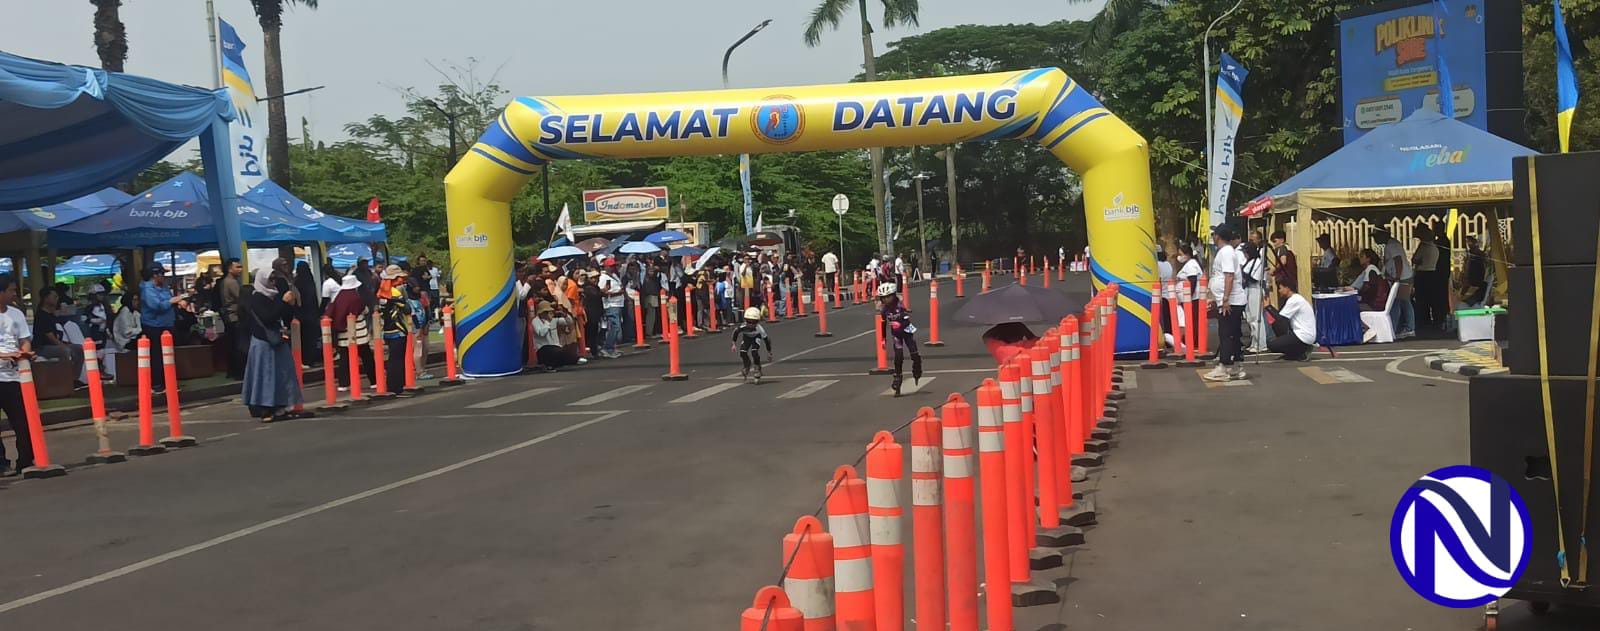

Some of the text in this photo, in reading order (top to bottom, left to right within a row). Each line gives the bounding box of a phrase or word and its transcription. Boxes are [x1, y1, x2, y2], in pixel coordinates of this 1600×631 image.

[538, 106, 740, 145] SELAMAT
[831, 88, 1018, 132] DATANG
[1347, 186, 1450, 203] KECAMATAN
[600, 199, 653, 211] Indomaret
[1125, 204, 1139, 214] bjb
[129, 207, 188, 219] bank bjb
